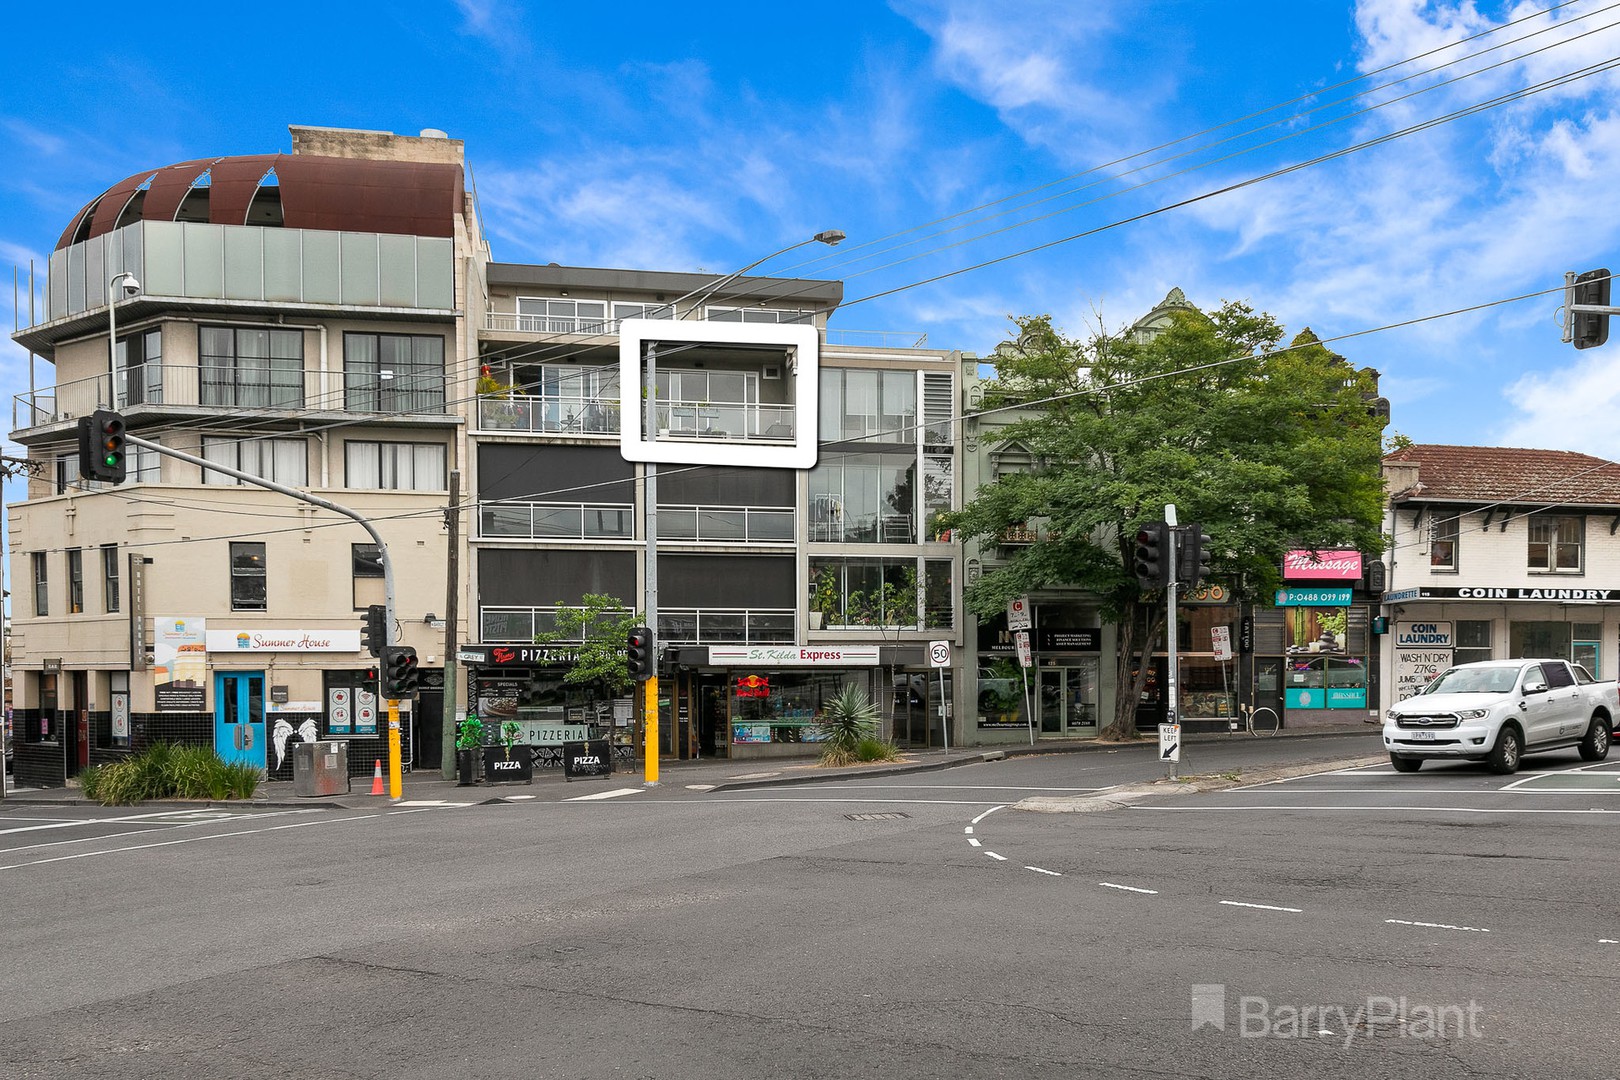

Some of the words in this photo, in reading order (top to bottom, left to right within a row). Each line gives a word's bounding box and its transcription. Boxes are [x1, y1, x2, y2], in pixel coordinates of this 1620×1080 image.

[1338, 593, 1351, 601] 199
[1384, 590, 1418, 601] LAUNDRETTE
[1458, 588, 1508, 598] COIN
[1518, 588, 1611, 599] LAUNDRY
[1411, 624, 1437, 633] COIN
[252, 633, 296, 649] Summer
[297, 633, 331, 649] House
[1400, 633, 1449, 644] LAUNDRY
[800, 649, 841, 661] Express
[934, 649, 947, 659] 50
[1413, 664, 1437, 674] 27KG
[529, 730, 584, 741] PIZZERIA
[494, 761, 521, 770] PIZZA
[574, 756, 601, 765] PIZZA
